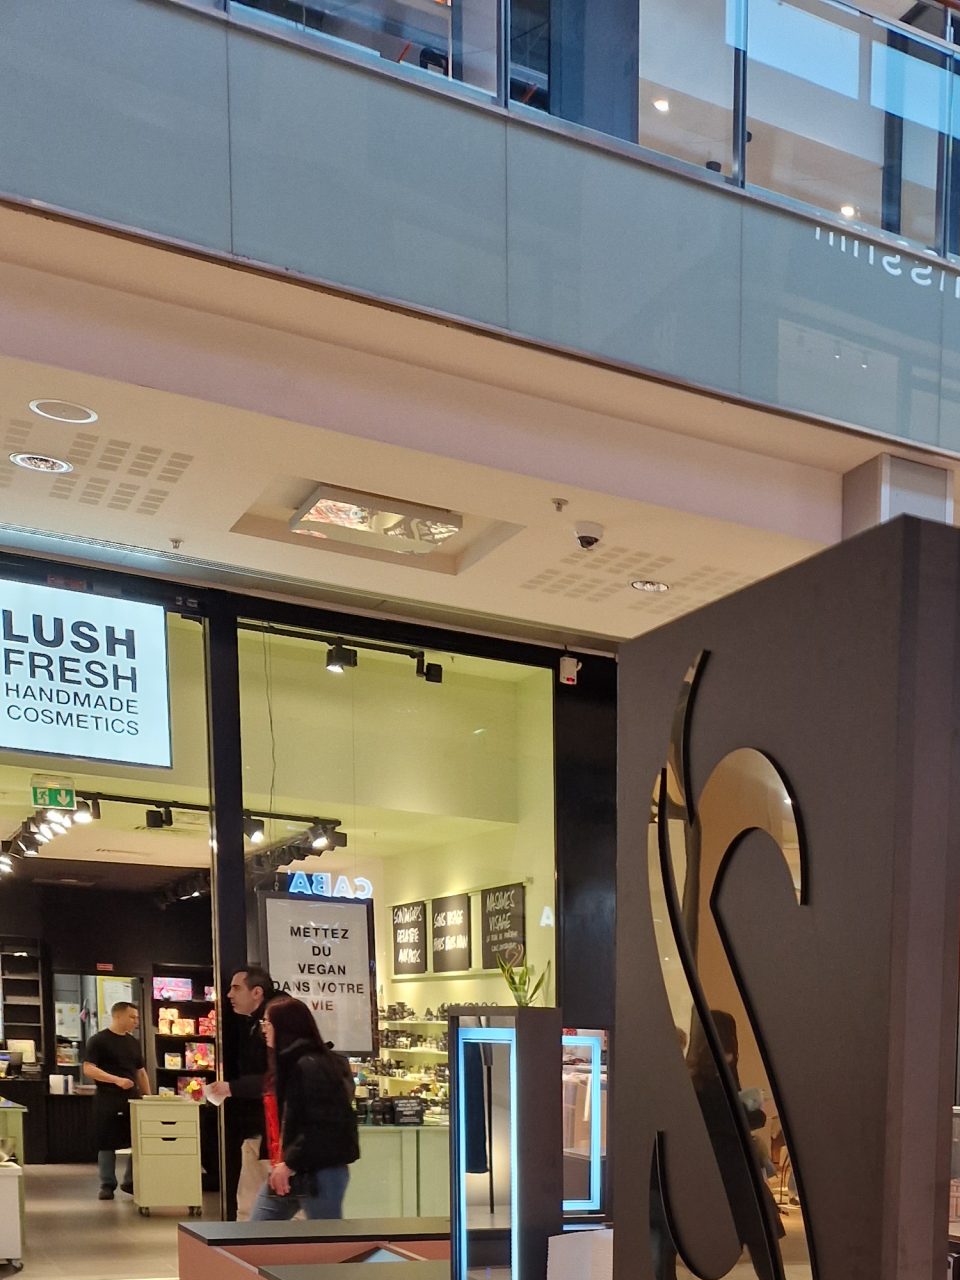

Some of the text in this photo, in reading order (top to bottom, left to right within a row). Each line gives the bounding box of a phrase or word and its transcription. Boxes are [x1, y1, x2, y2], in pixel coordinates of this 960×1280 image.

[2, 609, 136, 660] LUSH
[4, 648, 138, 693] FRESH
[5, 682, 139, 715] HANDMADE
[7, 704, 139, 736] COSMETICS
[290, 926, 349, 940] METTEZ
[312, 946, 331, 957] DU
[298, 963, 346, 975] VEGAN
[272, 980, 364, 994] DANS VOTRE
[311, 1001, 334, 1011] VIE
